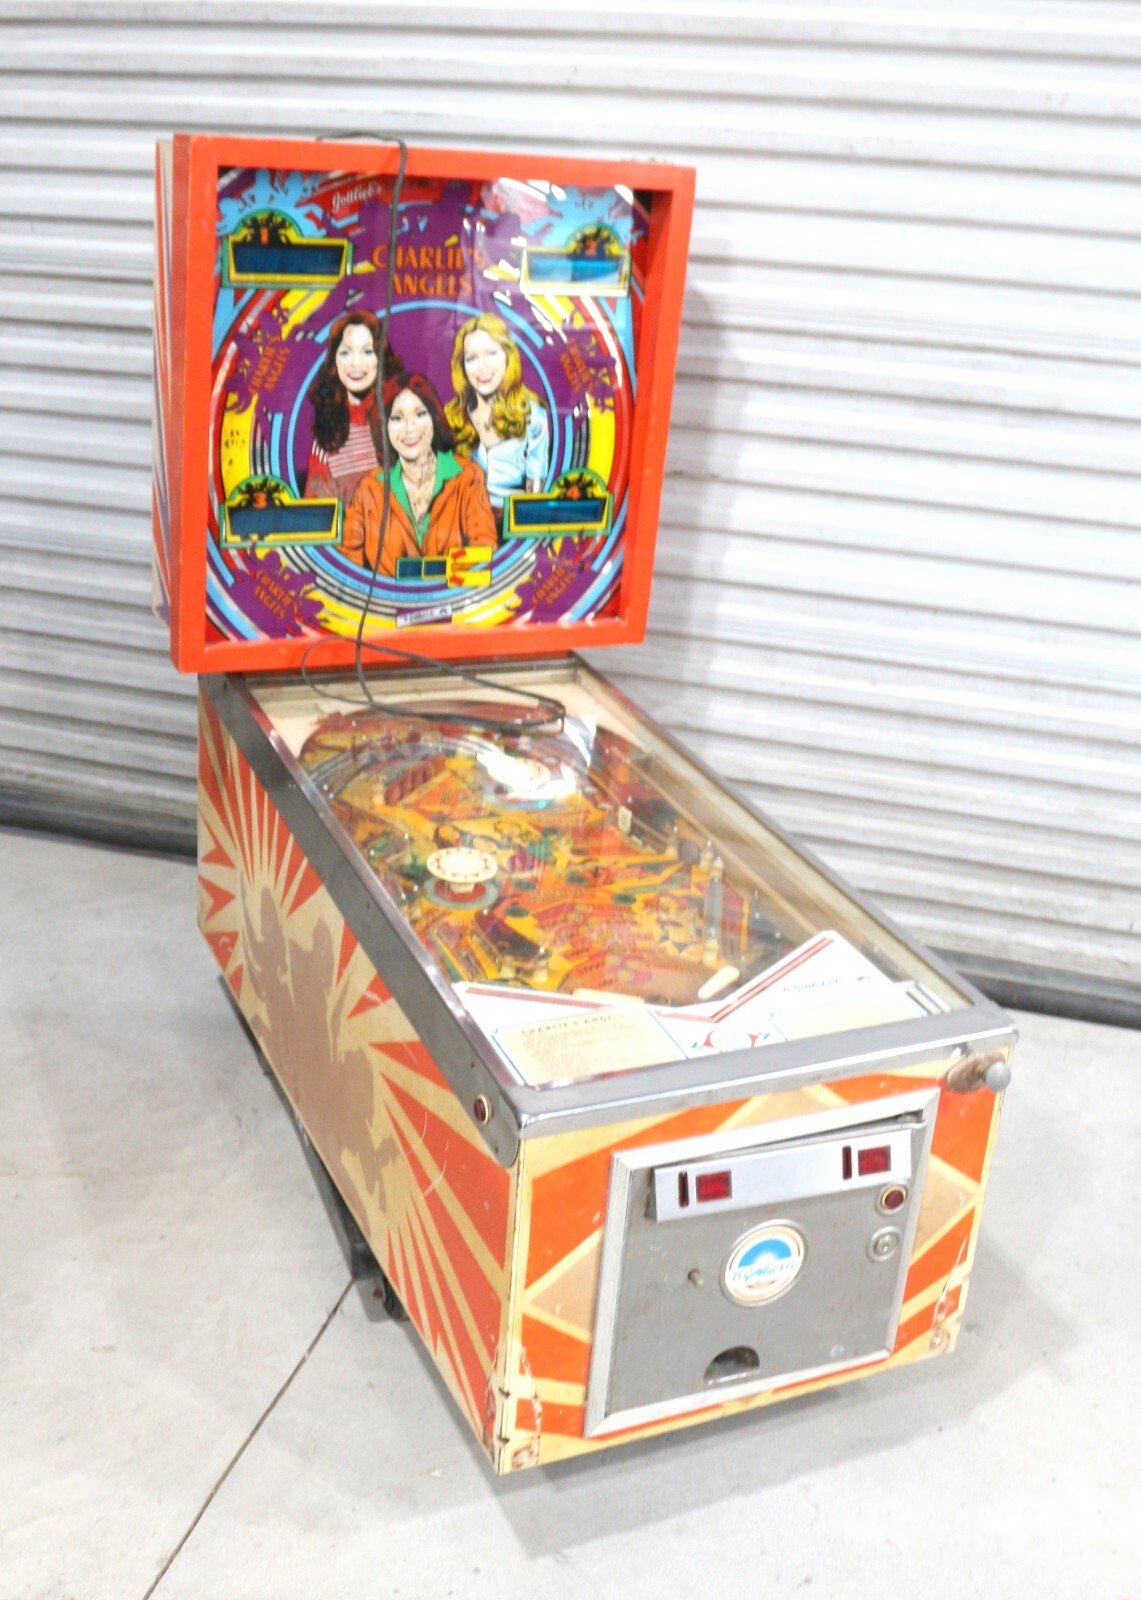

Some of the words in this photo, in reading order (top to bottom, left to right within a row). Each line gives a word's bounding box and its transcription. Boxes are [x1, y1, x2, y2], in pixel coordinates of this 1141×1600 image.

[332, 181, 382, 214] Gottlieb's
[253, 491, 267, 509] 3
[566, 485, 580, 500] 4
